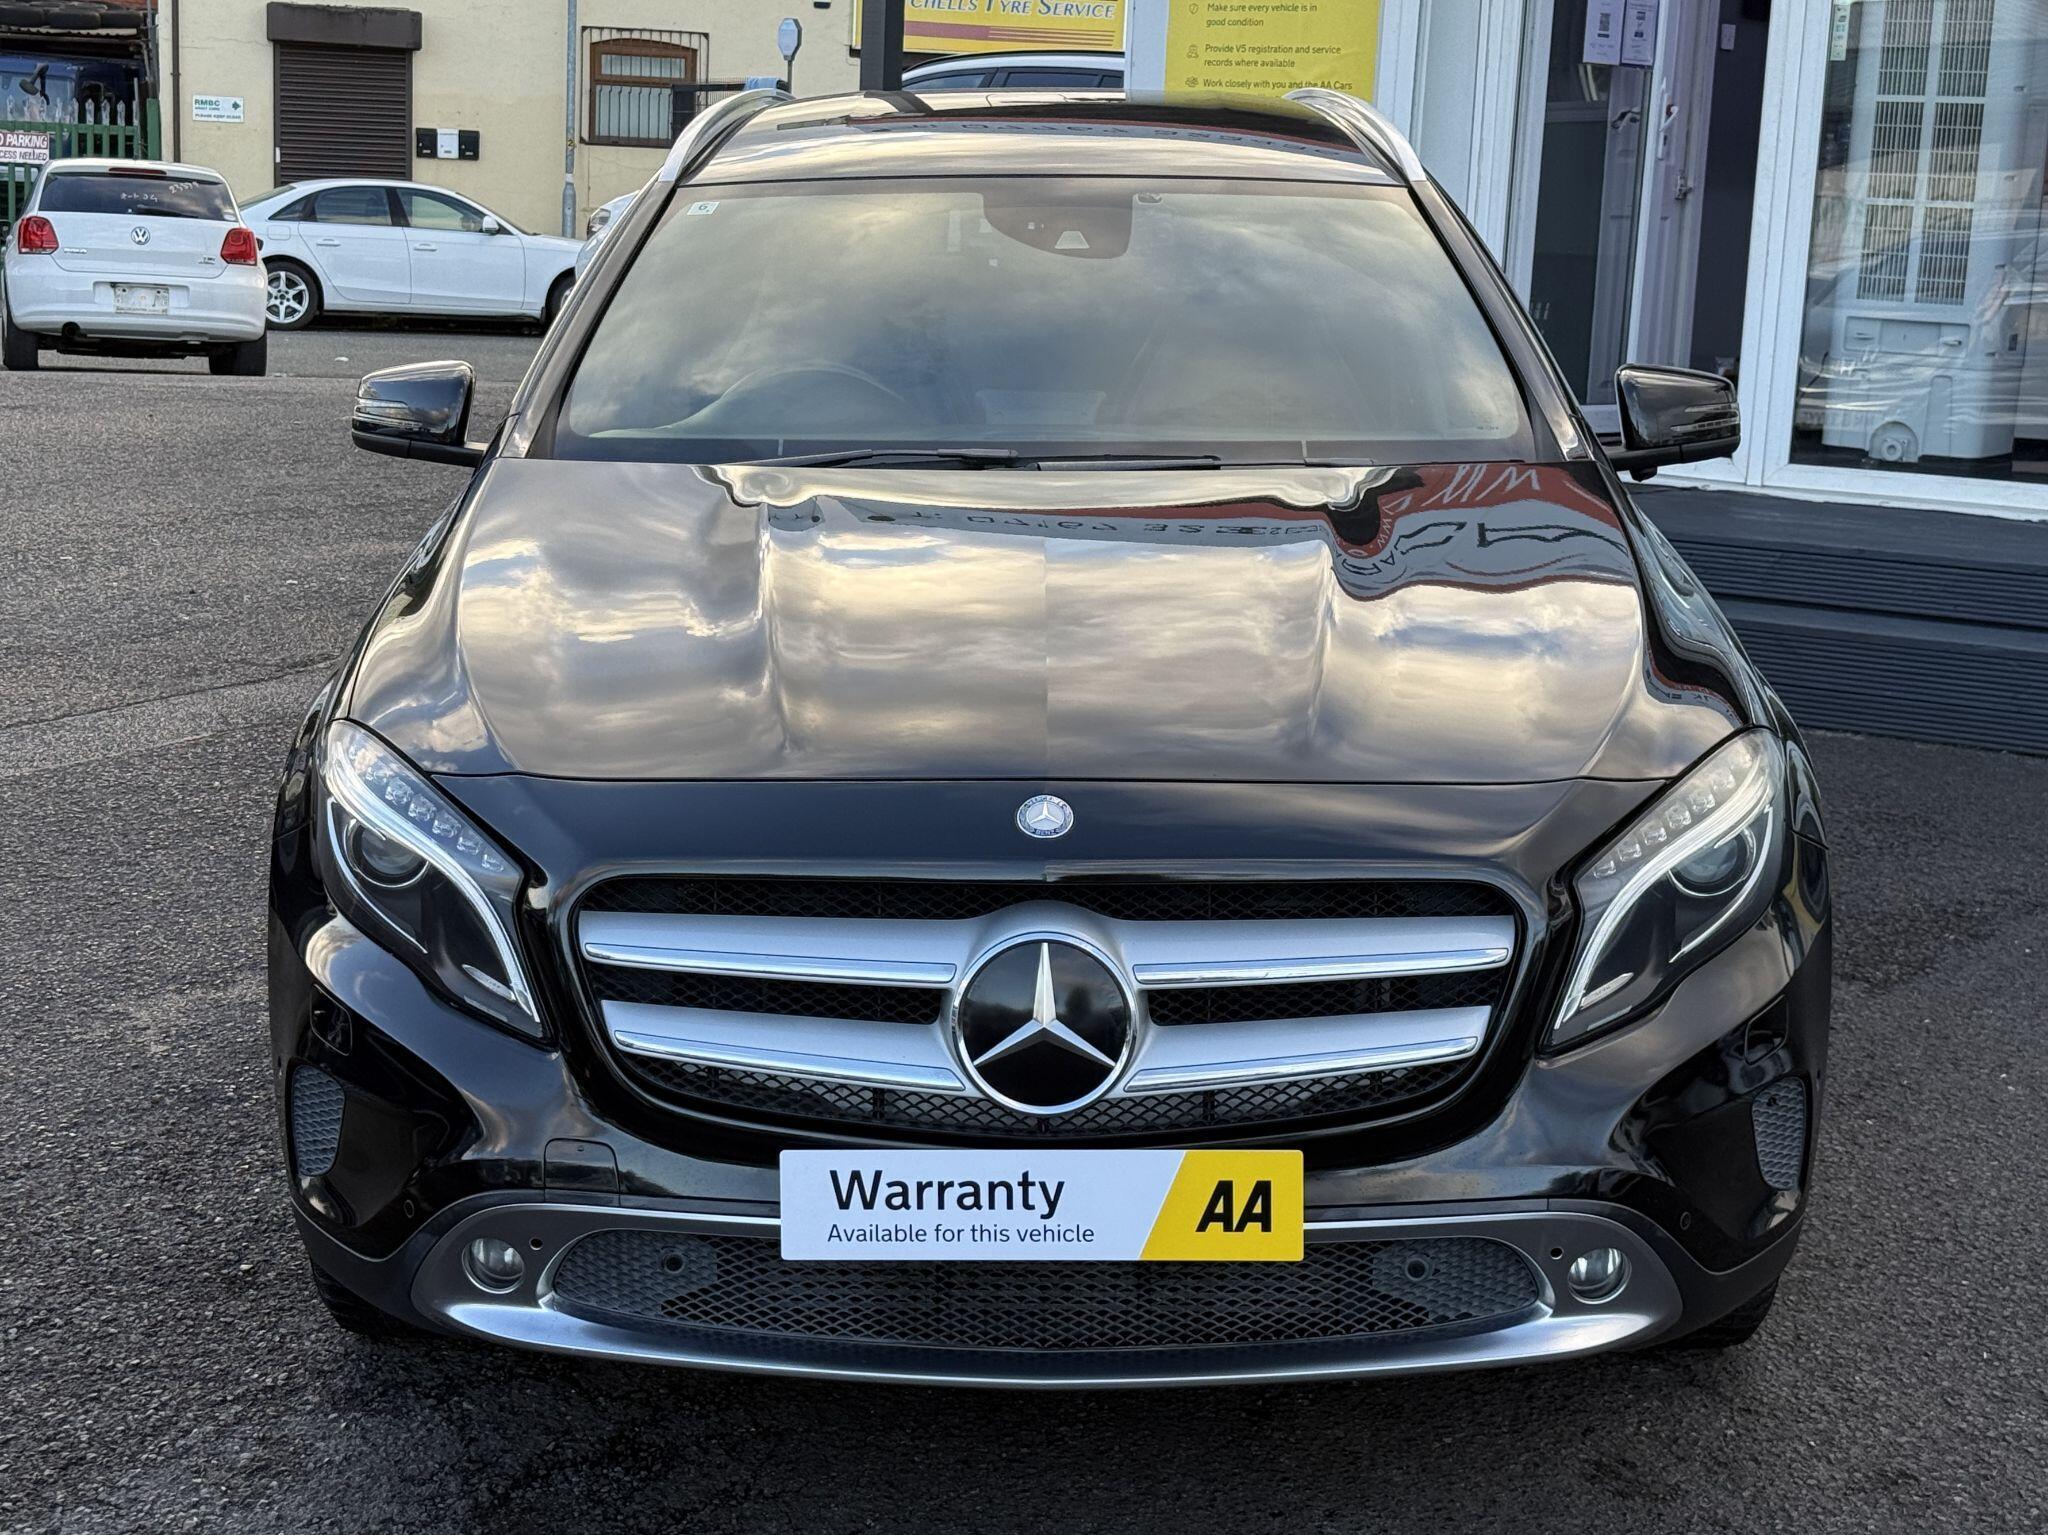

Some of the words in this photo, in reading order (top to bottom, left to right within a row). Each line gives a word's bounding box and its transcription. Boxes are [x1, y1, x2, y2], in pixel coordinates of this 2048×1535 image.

[1038, 0, 1115, 19] SERVICE
[1207, 3, 1228, 12] Make
[1249, 5, 1270, 14] every
[1271, 3, 1299, 12] vehicle
[1301, 3, 1308, 12] is
[1309, 4, 1318, 12] in
[1206, 18, 1226, 27] good
[1227, 18, 1264, 27] condition
[1205, 44, 1234, 54] Provide
[1235, 45, 1247, 53] V5
[1248, 45, 1293, 56] registration
[1294, 45, 1310, 54] and
[1312, 45, 1342, 55] service
[1204, 58, 1233, 67] records
[1234, 59, 1259, 67] where
[1260, 59, 1295, 68] available
[1203, 79, 1223, 88] Work
[1224, 80, 1251, 90] closely
[1252, 80, 1270, 89] with
[1271, 81, 1287, 90] you
[1333, 81, 1353, 90] Cars
[6, 133, 48, 148] PARKING
[829, 1169, 1066, 1220] Warranty
[1195, 1180, 1272, 1232] AA
[827, 1223, 928, 1243] Available
[934, 1223, 965, 1242] for
[971, 1224, 1010, 1242] this
[1016, 1223, 1095, 1243] vehicle
